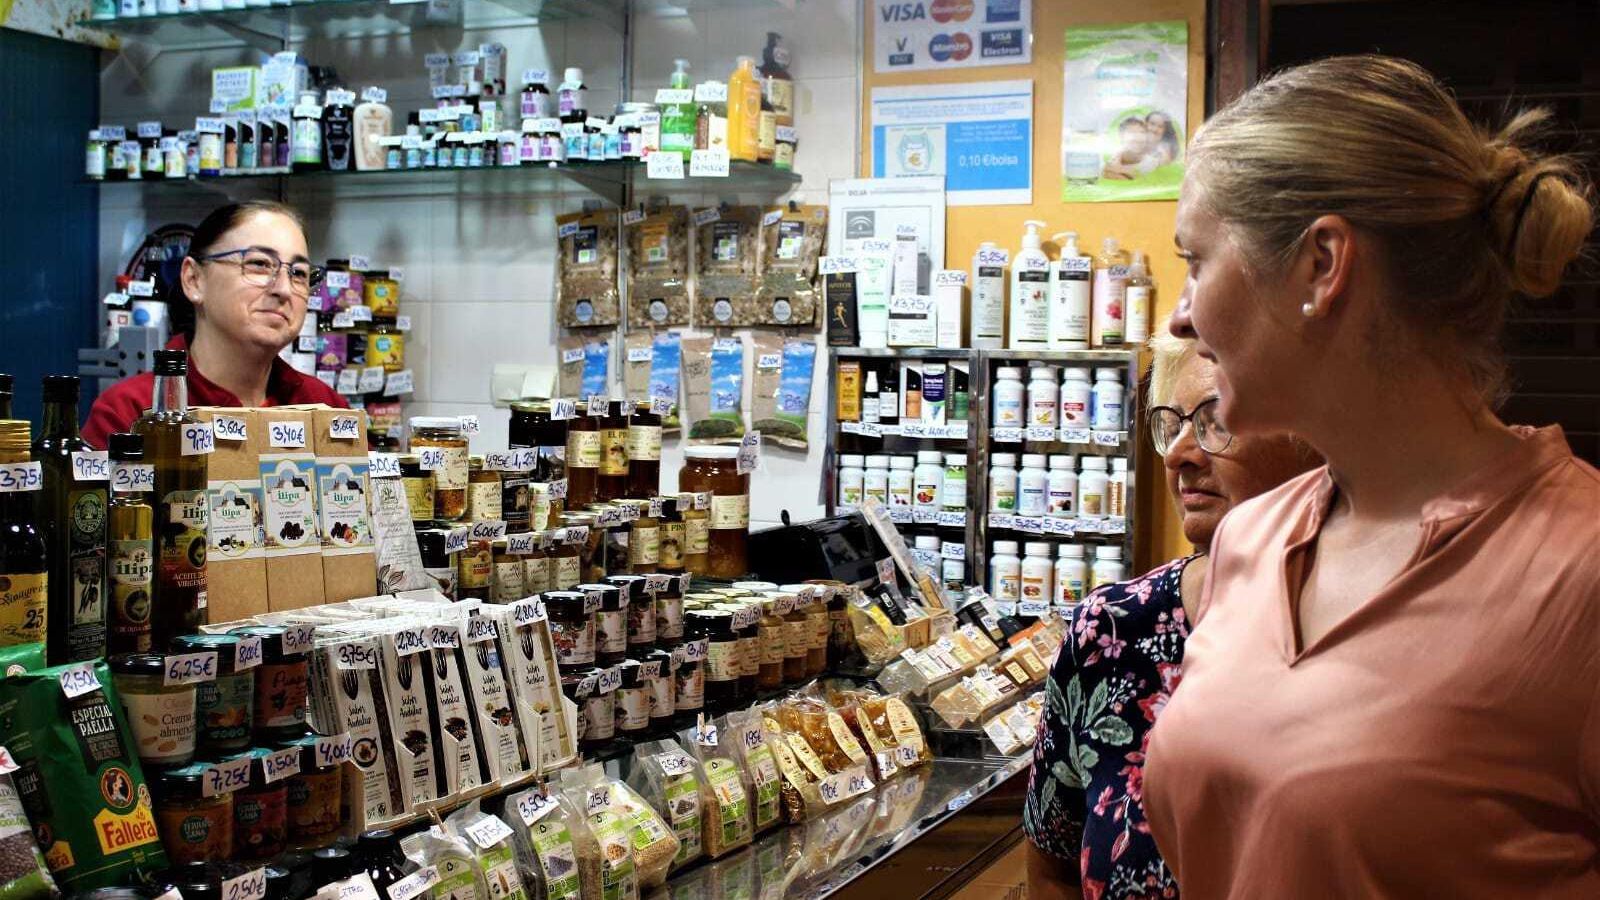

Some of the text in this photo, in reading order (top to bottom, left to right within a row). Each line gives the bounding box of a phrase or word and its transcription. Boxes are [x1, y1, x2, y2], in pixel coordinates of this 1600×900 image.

[881, 4, 926, 22] VISA
[991, 32, 1012, 41] VISA
[984, 47, 1020, 55] Electron
[959, 154, 981, 167] 0,10
[272, 426, 305, 444] 3,40€
[278, 490, 300, 502] ilipa
[333, 492, 354, 502] ilipa
[222, 507, 241, 518] ilipa
[24, 608, 45, 630] 25
[514, 603, 543, 623] 2,80€
[468, 619, 496, 638] 2,80€
[398, 631, 427, 650] 2,80€
[169, 656, 215, 681] 6,25€
[71, 704, 113, 724] ESPECIAL
[79, 717, 115, 737] PAELLA
[209, 765, 249, 791] 7,25€
[102, 820, 157, 849] Fallera
